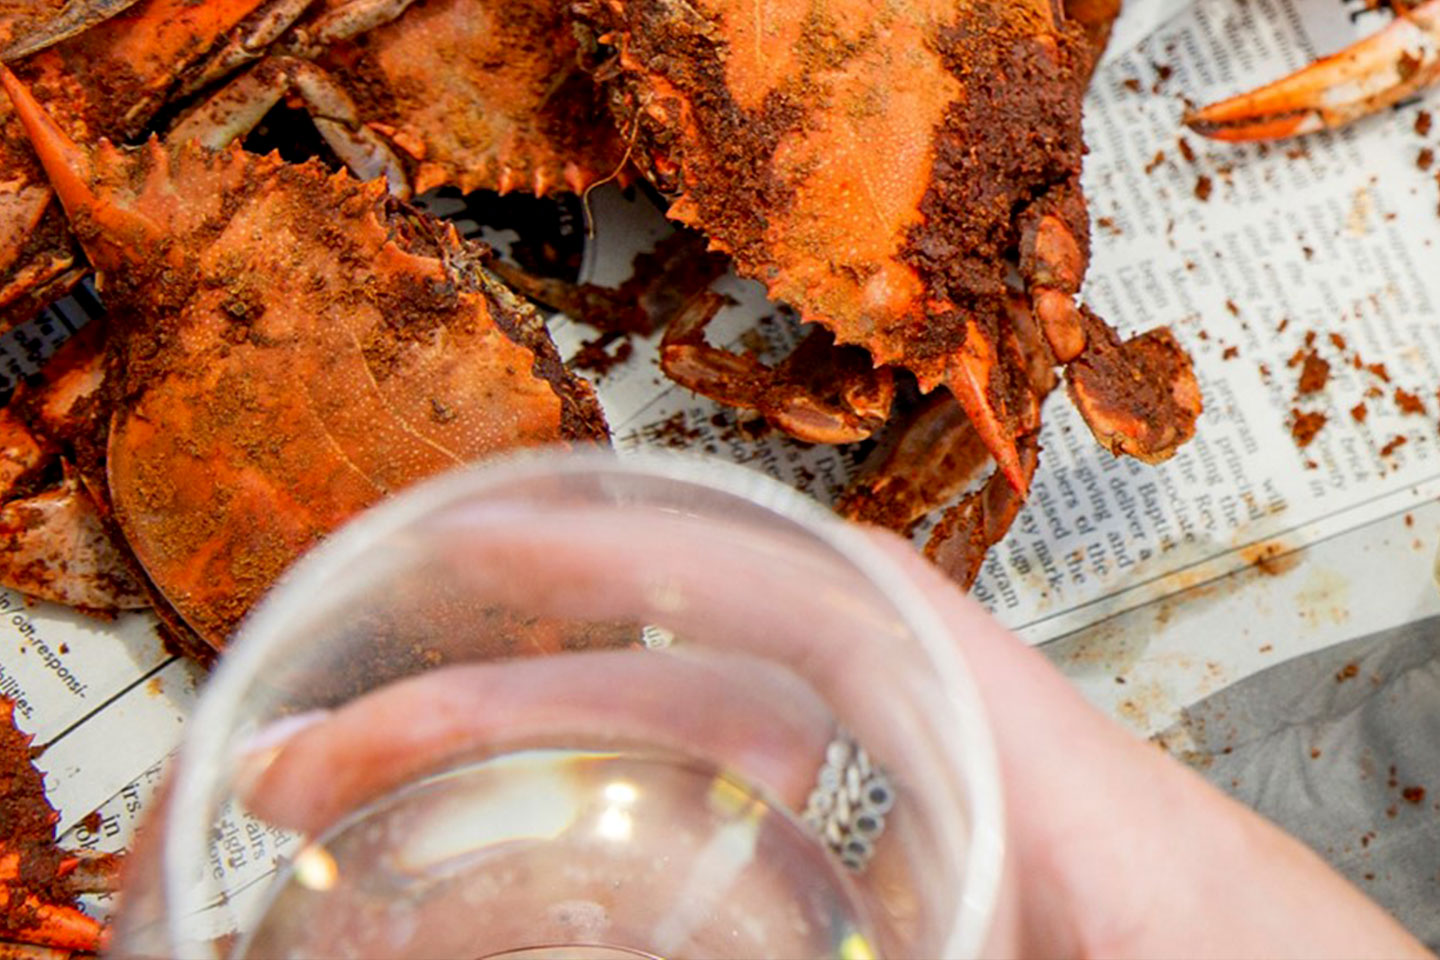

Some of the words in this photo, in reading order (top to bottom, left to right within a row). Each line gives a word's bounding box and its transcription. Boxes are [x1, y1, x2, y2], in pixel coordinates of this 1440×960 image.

[1046, 402, 1114, 525] thanksgiving
[1103, 527, 1135, 570] and
[1107, 473, 1149, 542] deliver
[1134, 480, 1181, 554] Baptist
[1153, 461, 1201, 545] ssociate
[1031, 478, 1072, 541] raised
[1061, 549, 1091, 586] the
[1073, 513, 1097, 537] of
[1085, 541, 1114, 578] the
